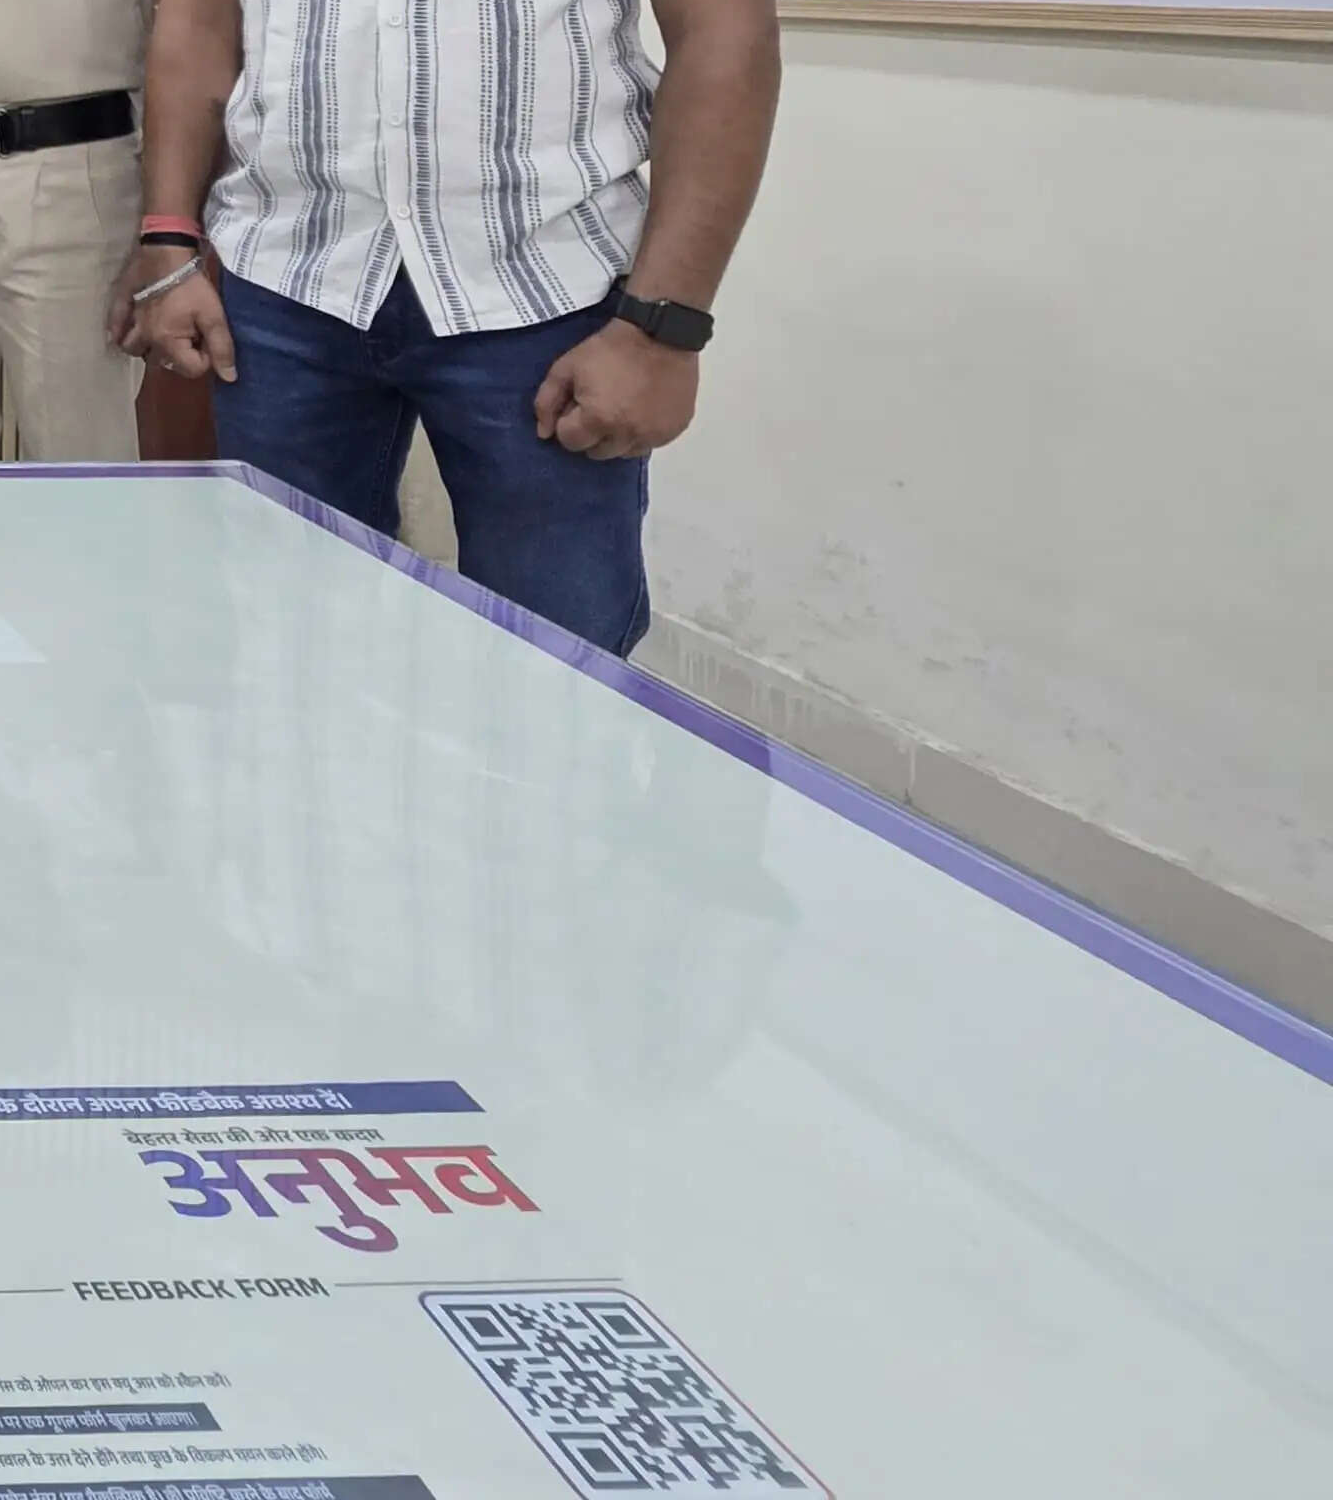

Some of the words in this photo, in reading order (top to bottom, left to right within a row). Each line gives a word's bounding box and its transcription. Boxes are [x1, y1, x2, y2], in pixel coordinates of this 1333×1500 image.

[18, 1092, 84, 1115] दौरान
[87, 1092, 153, 1113] अपना
[154, 1089, 245, 1112] फीडबैक
[245, 1092, 317, 1110] अवश्य
[122, 1128, 180, 1147] बेहतर
[182, 1127, 224, 1146] सेवा
[224, 1126, 254, 1145] की
[254, 1128, 292, 1145] ओर
[292, 1128, 332, 1143] एक
[332, 1128, 384, 1143] कदम
[137, 1145, 542, 1253] अनुभव
[71, 1278, 239, 1301] FEEDBACK
[239, 1277, 331, 1298] FORM
